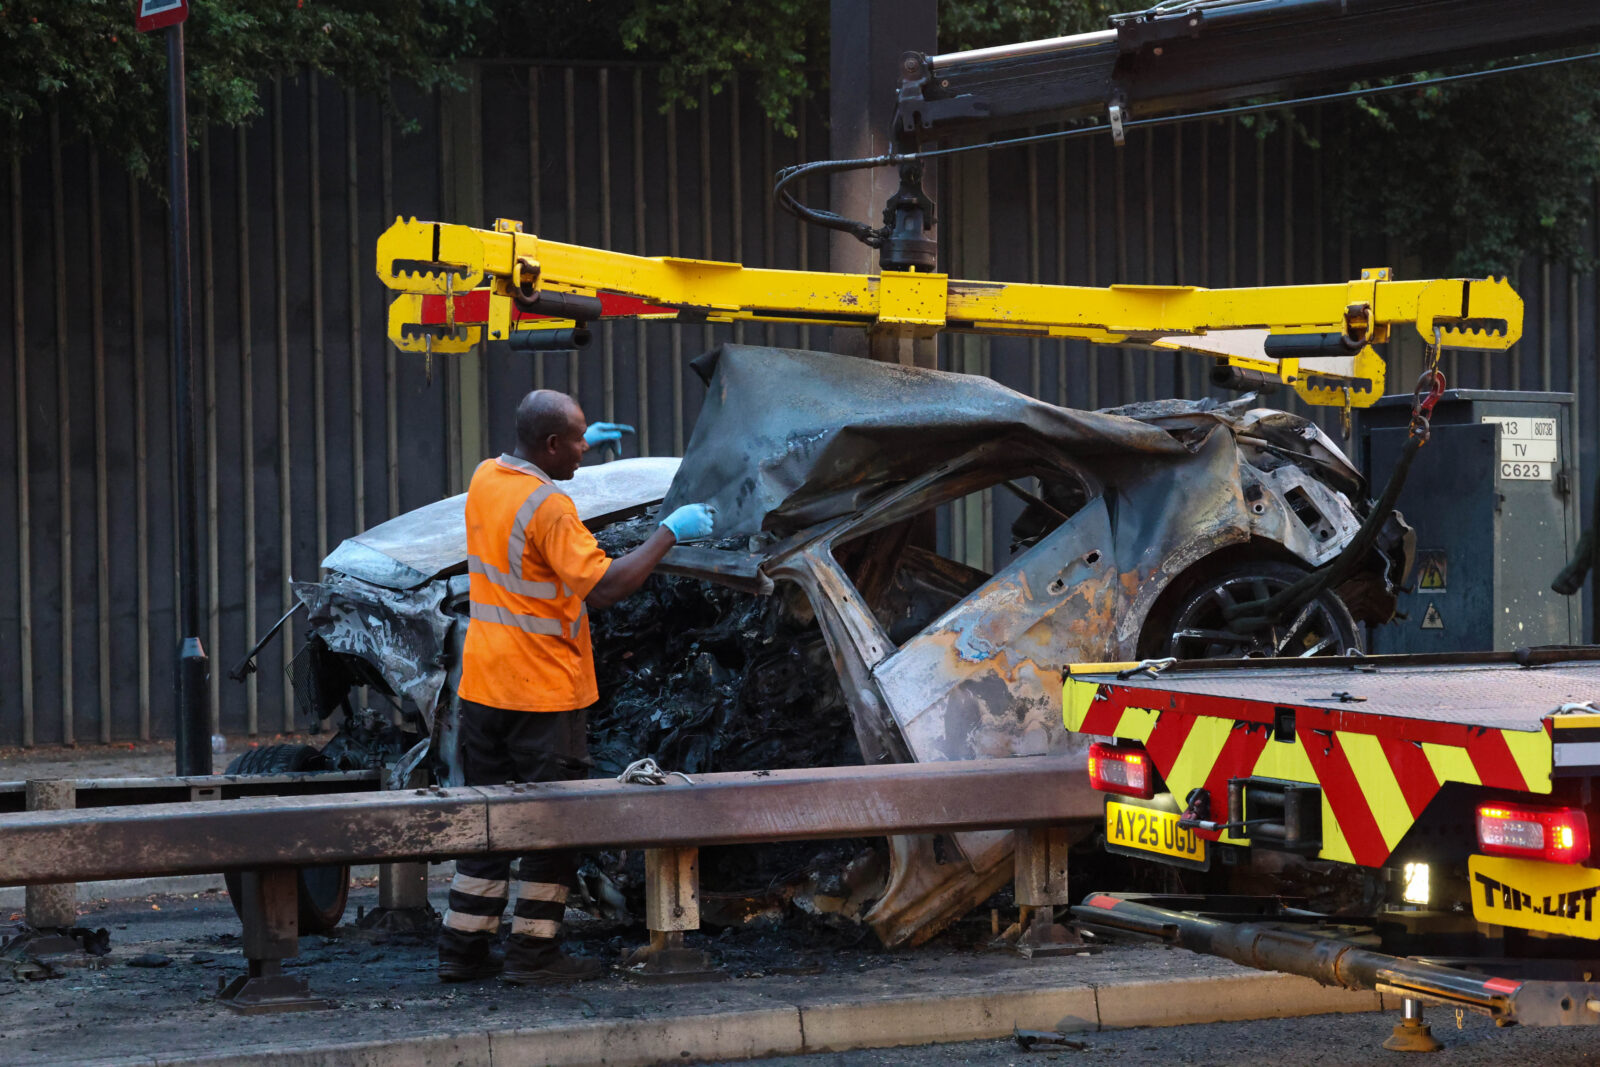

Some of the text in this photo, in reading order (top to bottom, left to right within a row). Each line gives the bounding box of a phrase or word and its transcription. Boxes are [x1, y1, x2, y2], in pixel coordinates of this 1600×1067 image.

[1500, 421, 1518, 435] A13
[1512, 443, 1527, 457] TV
[1501, 463, 1540, 478] C623
[1115, 809, 1159, 846] AY25
